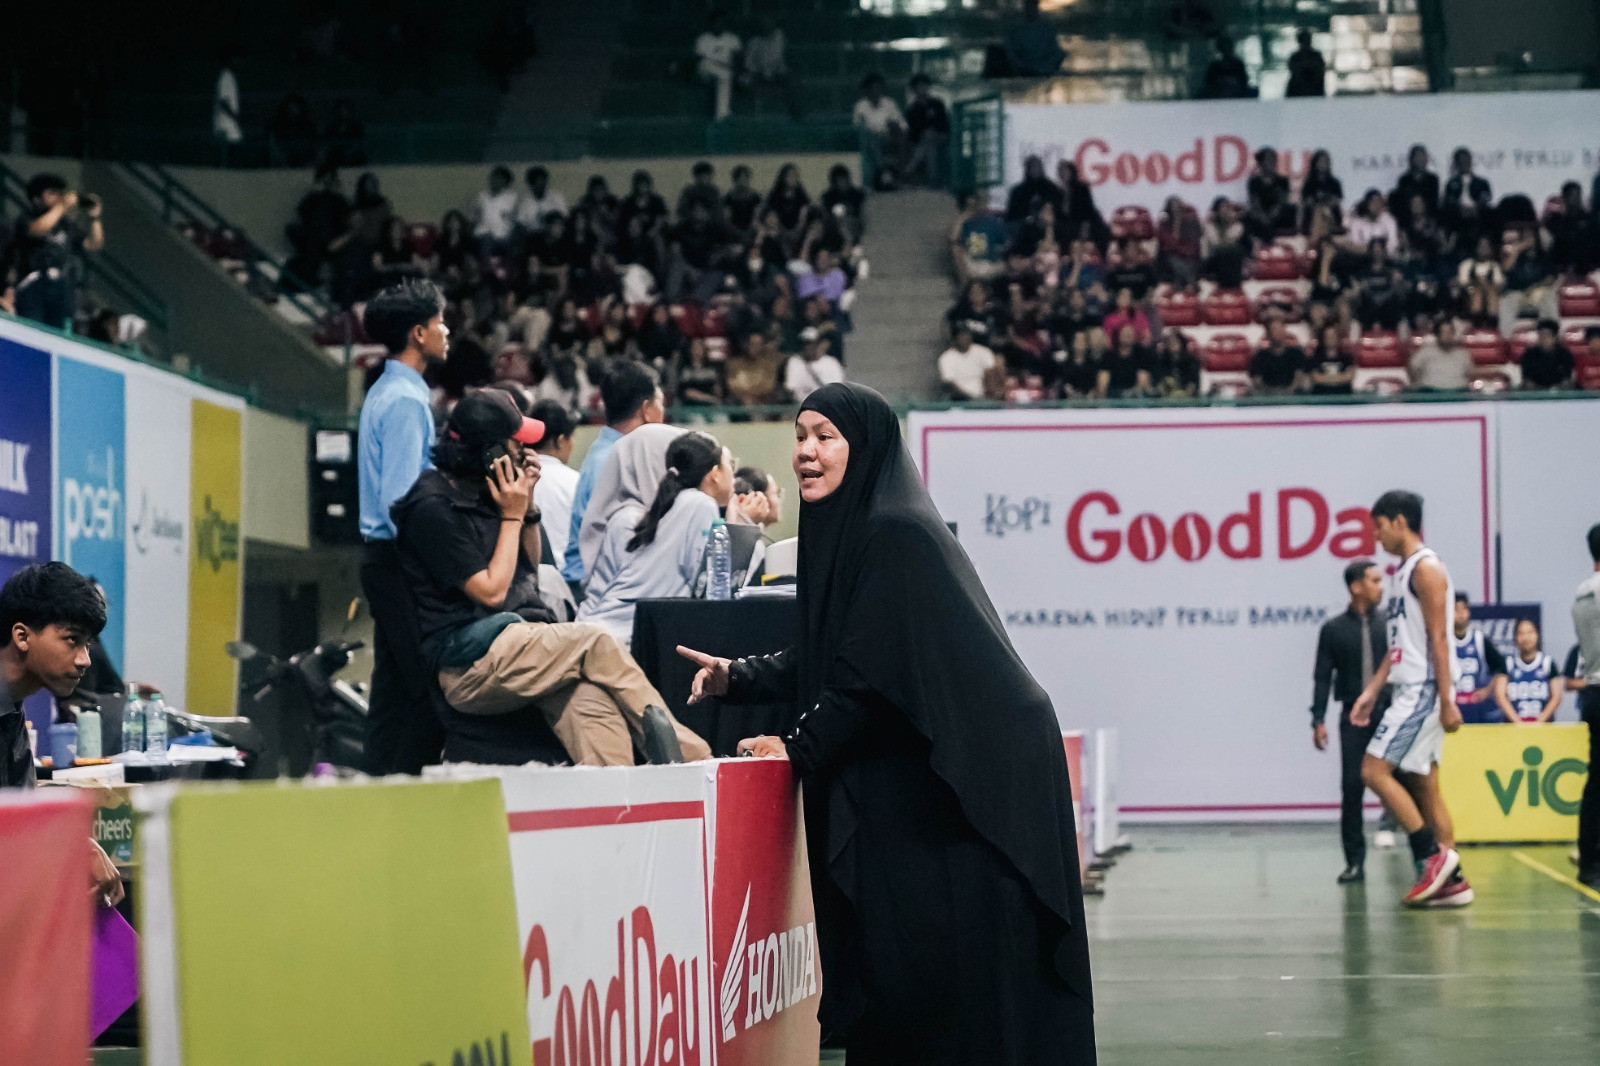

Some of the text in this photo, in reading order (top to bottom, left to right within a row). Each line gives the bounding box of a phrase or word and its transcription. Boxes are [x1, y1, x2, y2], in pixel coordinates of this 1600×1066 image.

[1073, 135, 1205, 186] Good
[1065, 490, 1262, 563] Good
[1278, 487, 1380, 561] Da
[523, 917, 626, 1066] Good
[745, 922, 817, 1030] HONDA
